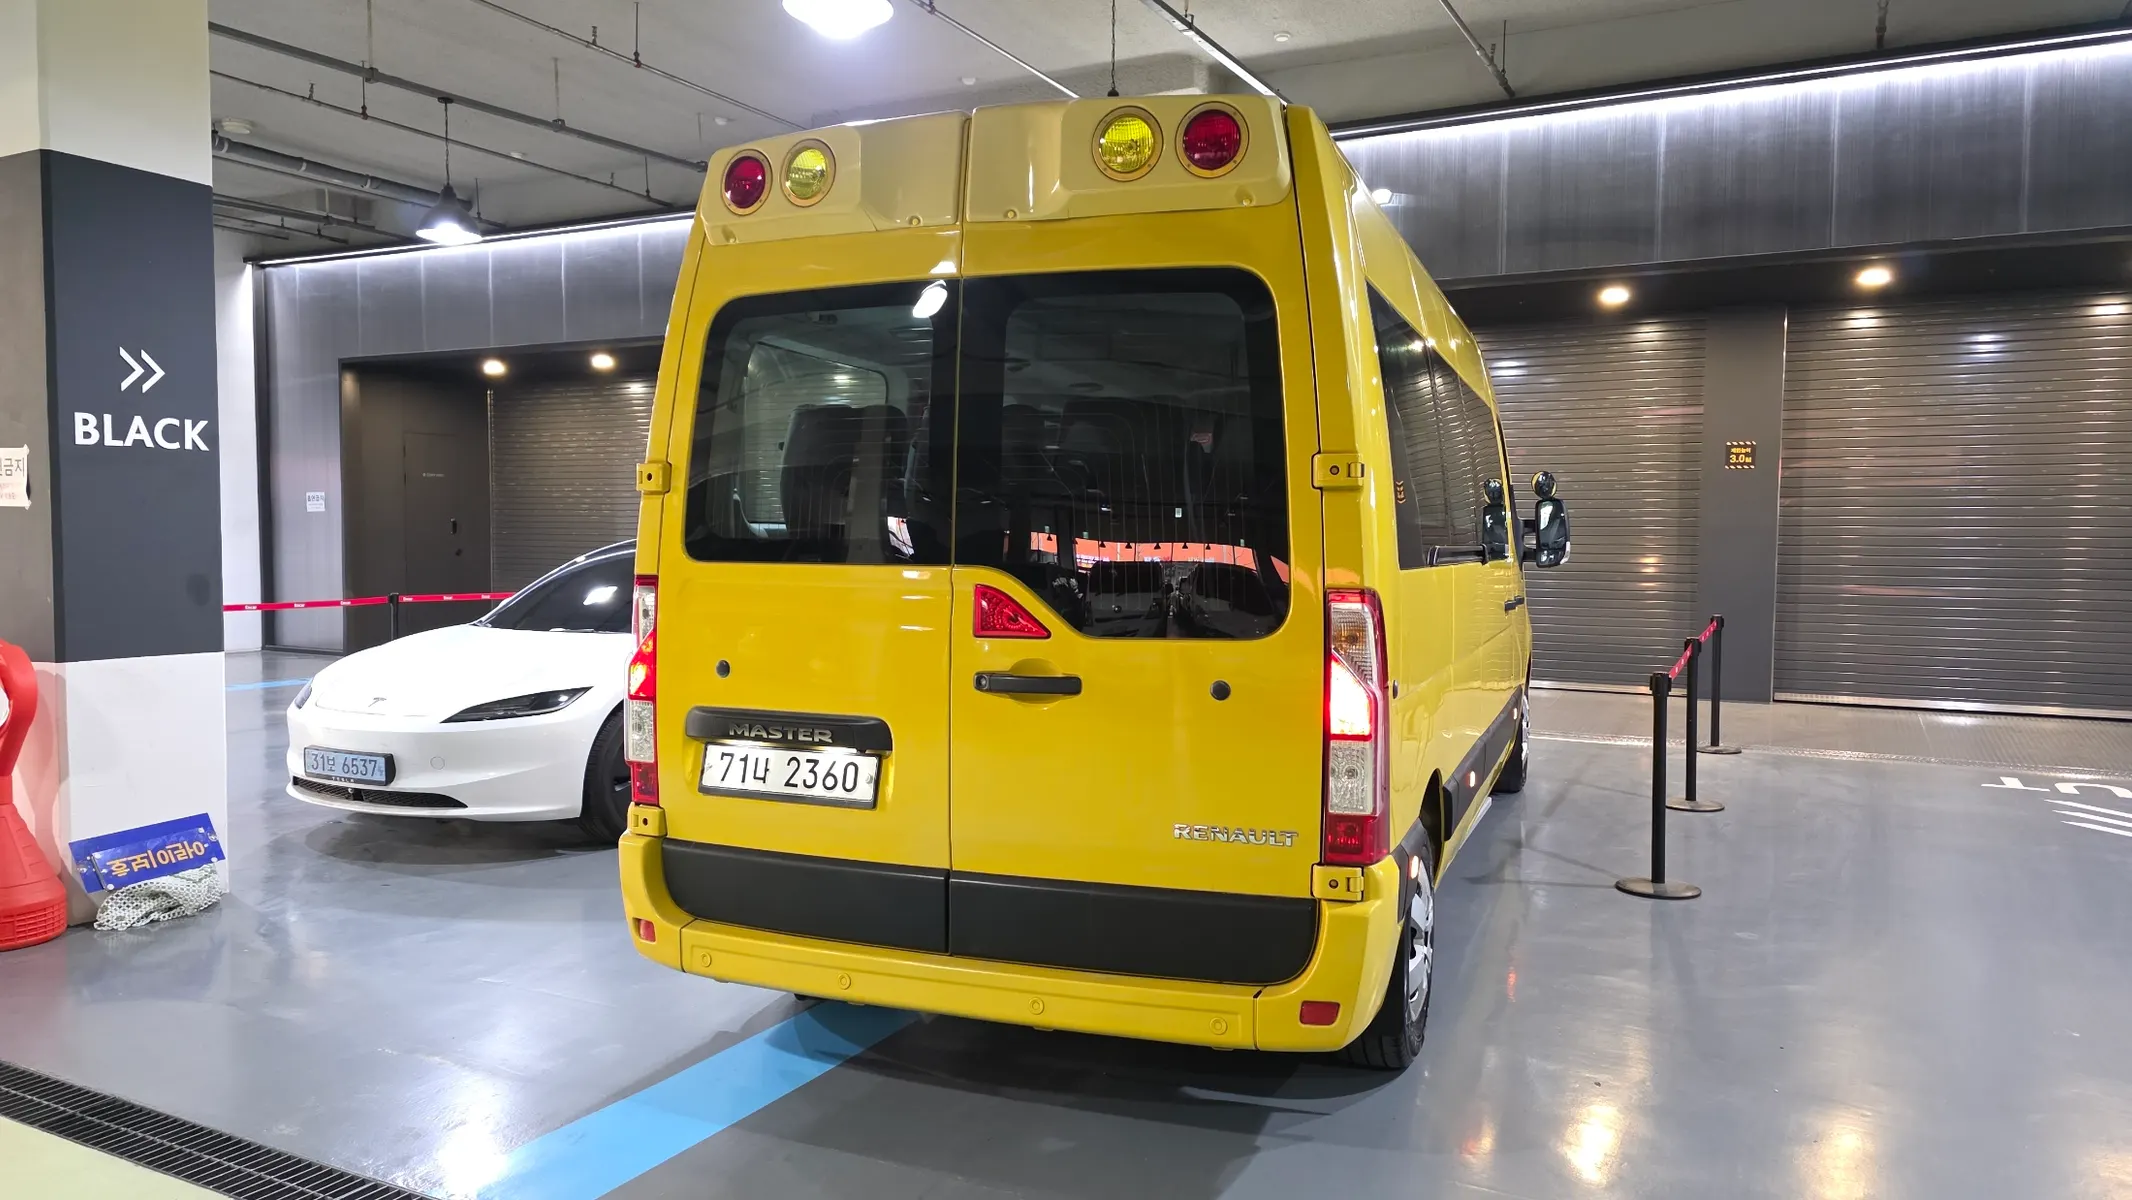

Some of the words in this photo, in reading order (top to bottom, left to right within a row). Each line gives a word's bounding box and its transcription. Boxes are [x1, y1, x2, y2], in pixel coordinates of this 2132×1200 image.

[74, 412, 209, 452] BLACK
[729, 723, 833, 743] MASTER
[311, 753, 336, 772] 31보
[342, 756, 378, 777] 6537
[720, 752, 770, 784] 71나
[784, 756, 859, 793] 2360
[1173, 823, 1299, 847] RENAULT
[106, 840, 206, 878] 어린이보호
